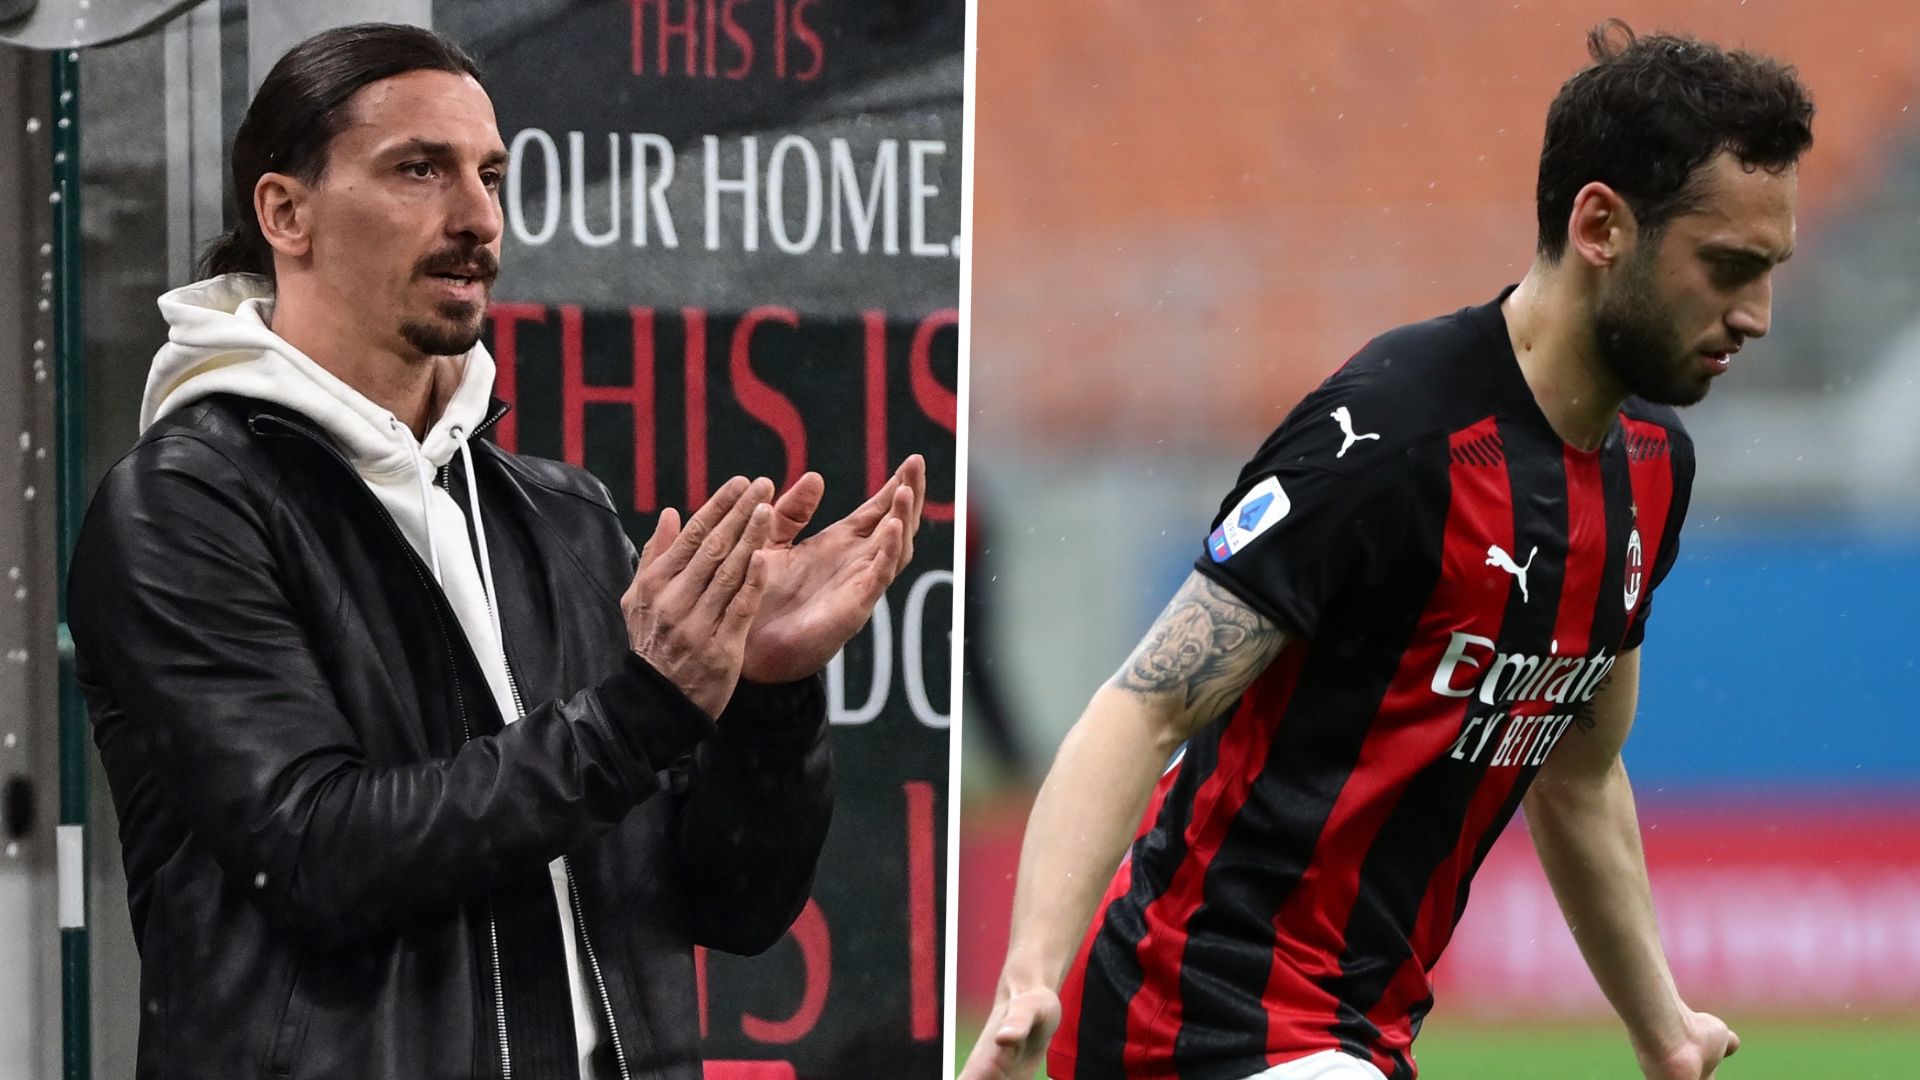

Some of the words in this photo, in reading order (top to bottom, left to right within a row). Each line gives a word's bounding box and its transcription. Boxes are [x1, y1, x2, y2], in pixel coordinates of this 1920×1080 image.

[629, 0, 755, 80] THIS
[773, 0, 825, 82] IS
[506, 127, 679, 249] OUR
[487, 302, 808, 515] THIS
[1489, 714, 1573, 767] BETTER
